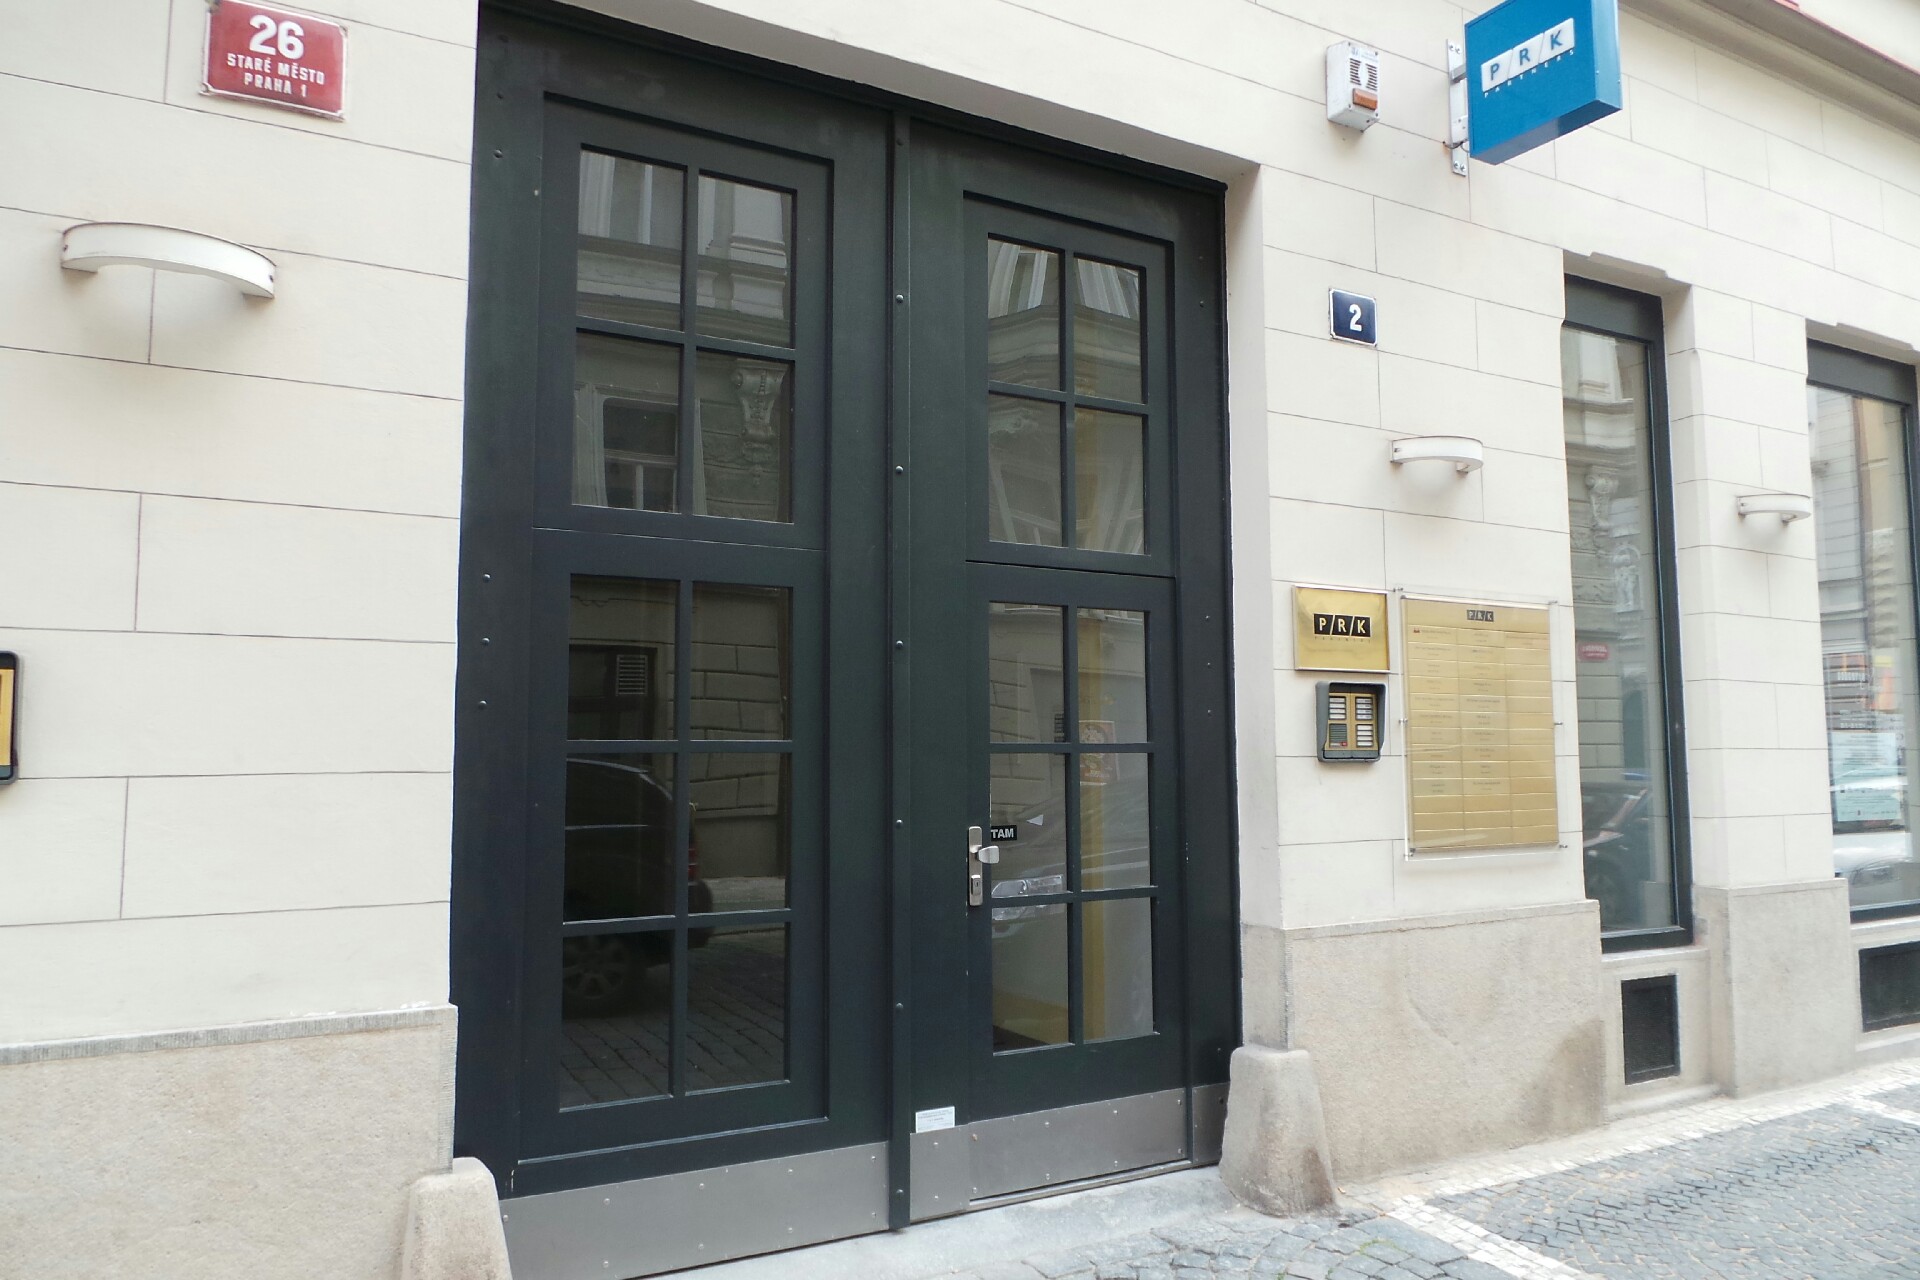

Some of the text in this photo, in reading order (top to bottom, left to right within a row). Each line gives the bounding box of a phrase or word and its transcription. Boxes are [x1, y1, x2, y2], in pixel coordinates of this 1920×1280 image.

[249, 14, 304, 59] 26
[227, 53, 325, 85] STARÉ MĚSTO
[244, 72, 307, 98] PRAHA 1
[1349, 304, 1362, 332] 2
[991, 828, 1014, 838] TAM
